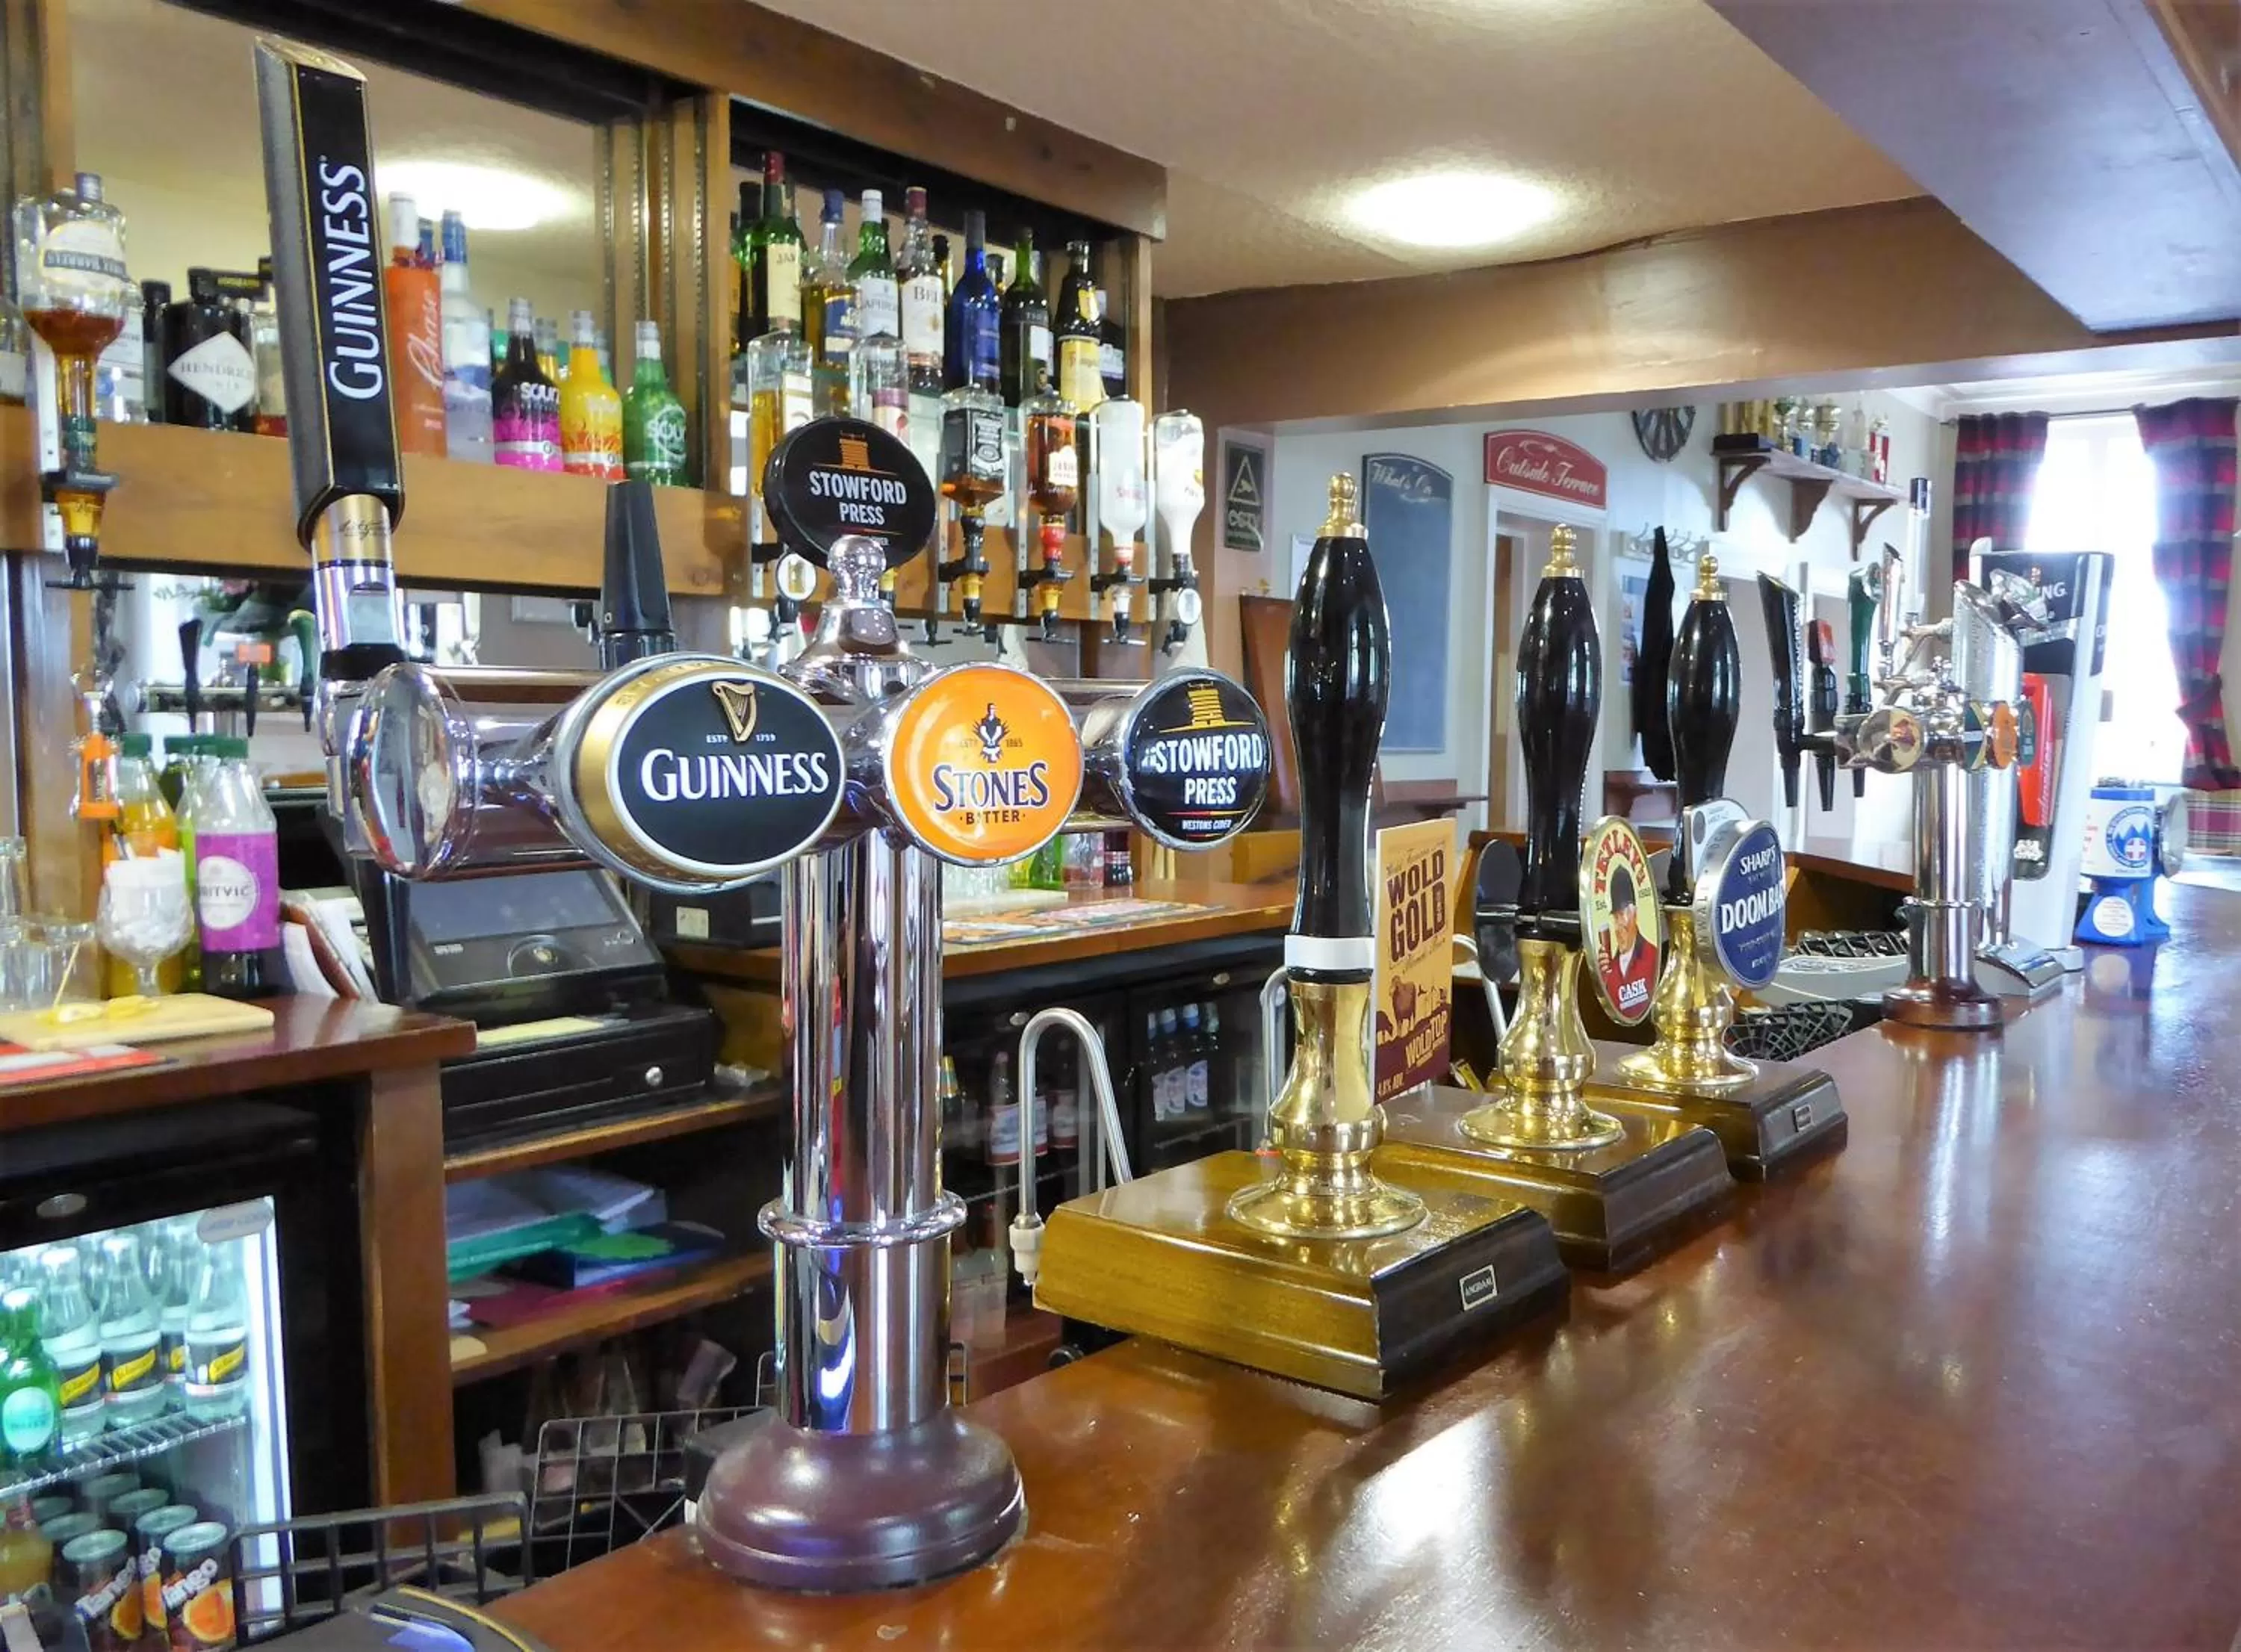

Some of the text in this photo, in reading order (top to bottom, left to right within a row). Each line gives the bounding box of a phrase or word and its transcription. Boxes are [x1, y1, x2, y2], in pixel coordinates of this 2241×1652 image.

[319, 162, 383, 400] GUINNESS
[1496, 445, 1549, 483] Outside
[809, 470, 907, 505] STOWFORD
[839, 501, 886, 526] PRESS
[1155, 733, 1264, 774] STOWFORD
[640, 748, 830, 802] GUINNESS
[934, 761, 1050, 813] STONES
[1184, 776, 1238, 805] PRESS
[1387, 849, 1445, 910] WOLD
[1740, 843, 1776, 876] SHARP'S
[1389, 881, 1446, 963] GOLD
[1720, 889, 1767, 934] DOOM
[1618, 978, 1648, 1002] CASK
